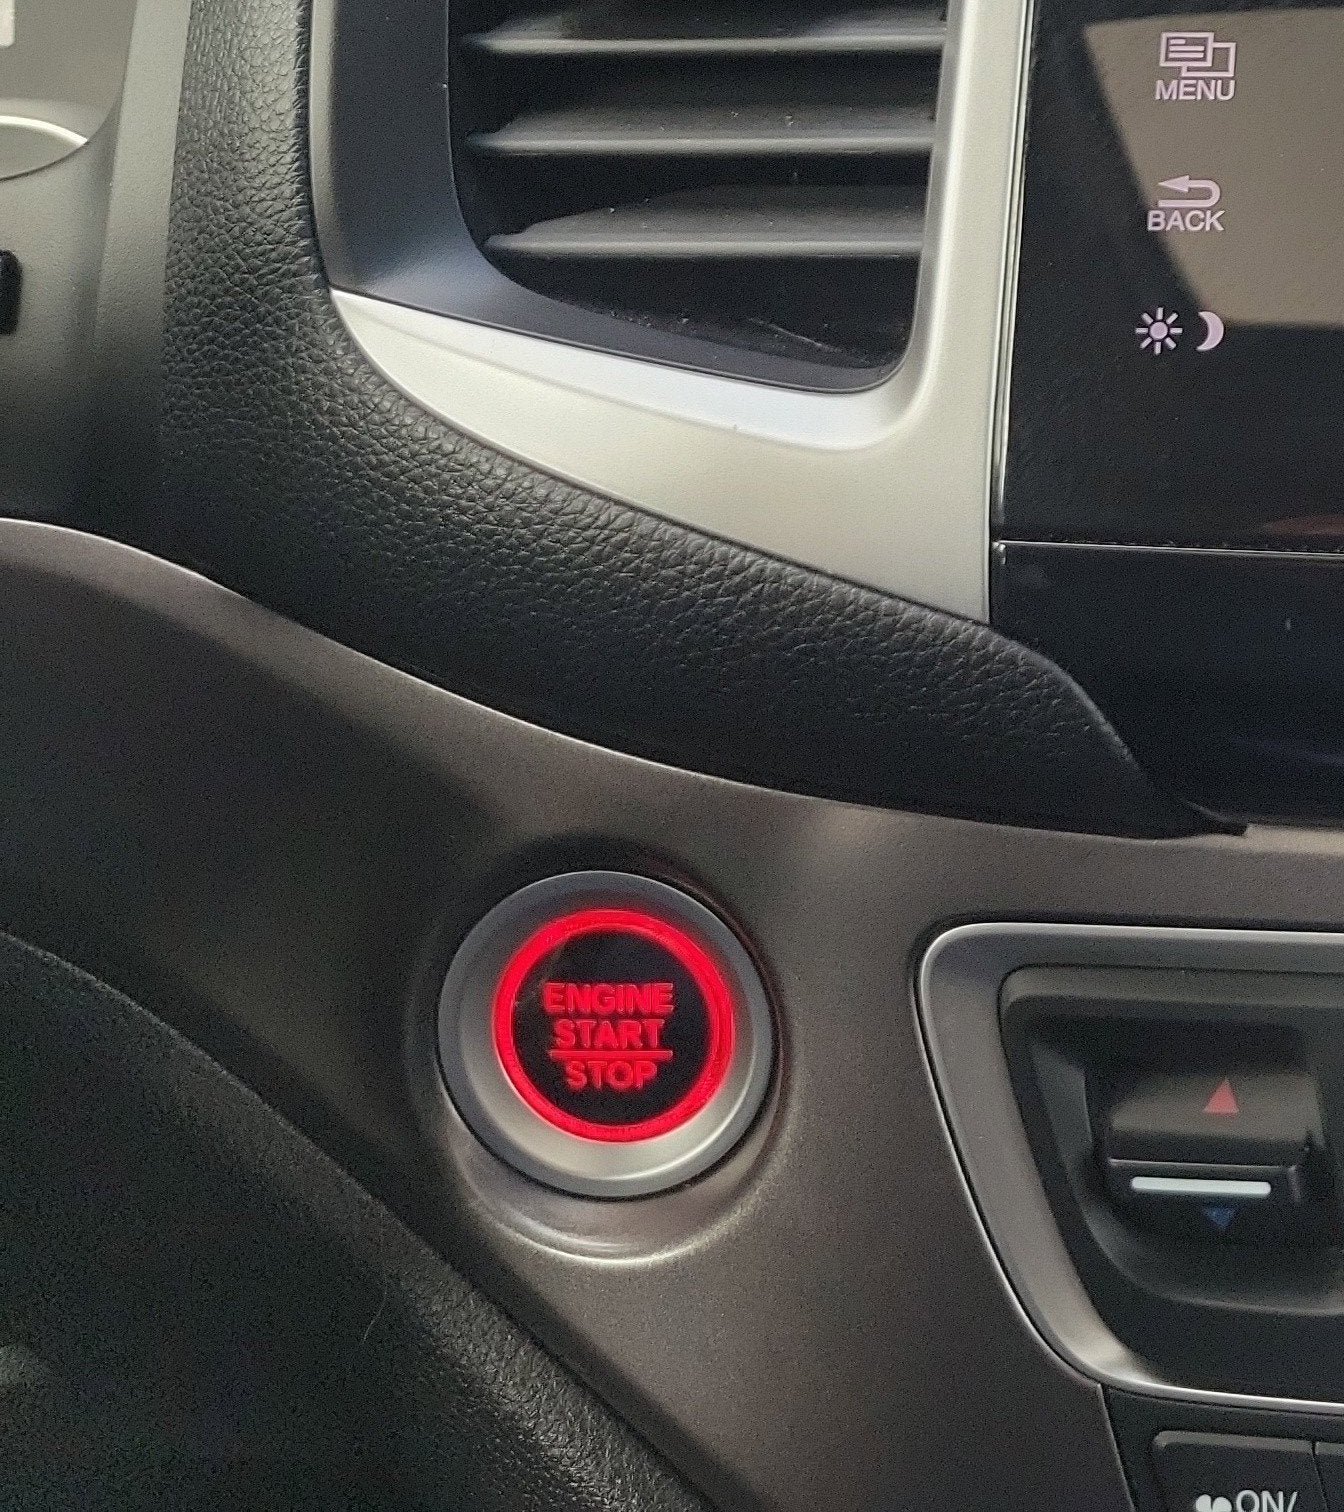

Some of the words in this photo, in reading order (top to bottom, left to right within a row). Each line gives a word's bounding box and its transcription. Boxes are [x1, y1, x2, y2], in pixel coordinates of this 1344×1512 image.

[1155, 79, 1237, 101] MENU
[1146, 210, 1226, 232] BACK
[541, 981, 674, 1013] ENGINE
[553, 1018, 665, 1049] START
[566, 1060, 657, 1090] STOP
